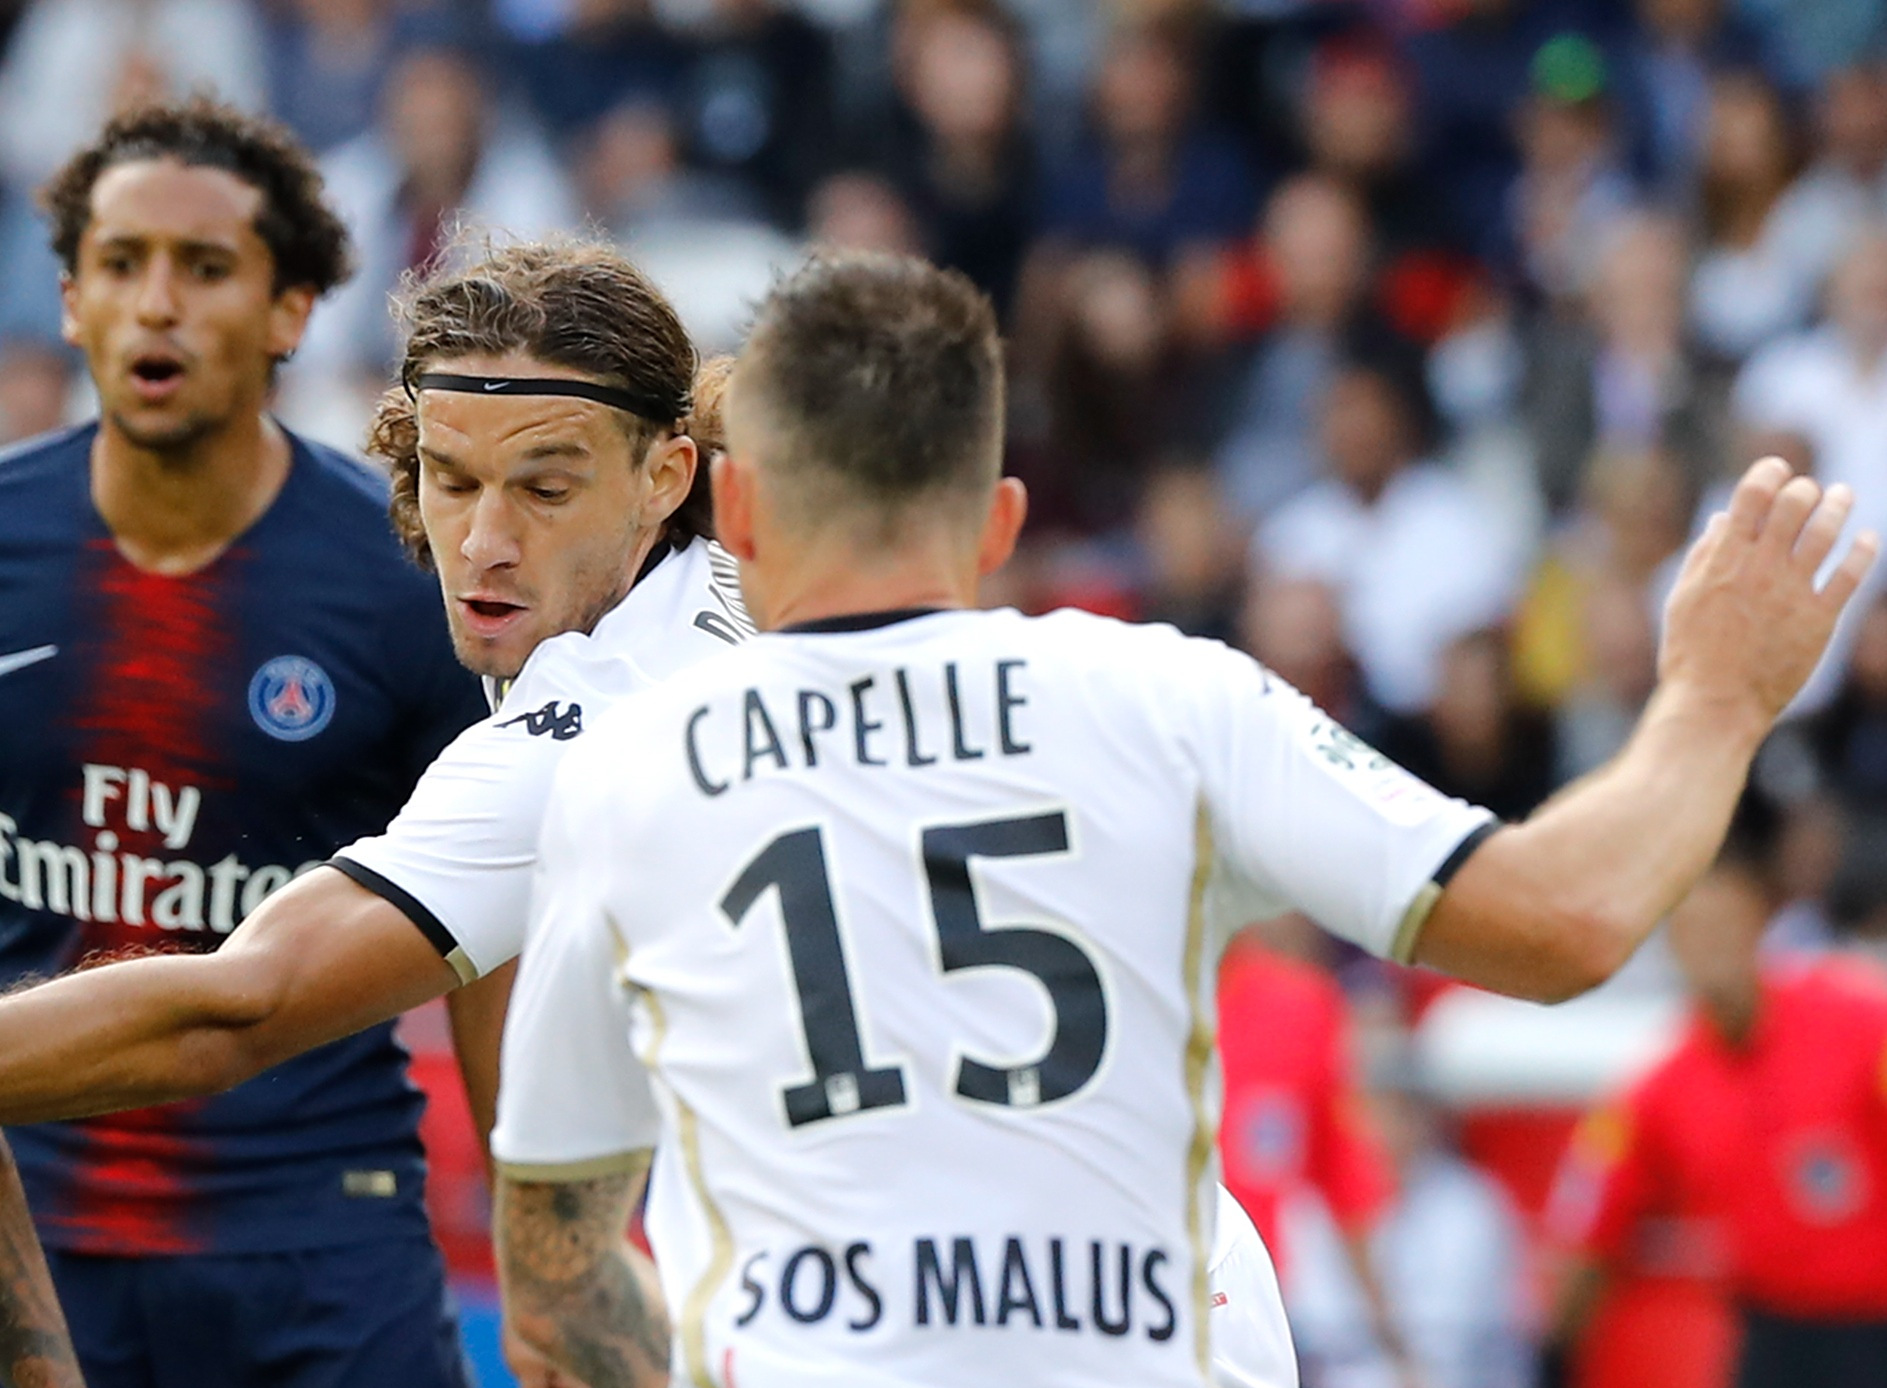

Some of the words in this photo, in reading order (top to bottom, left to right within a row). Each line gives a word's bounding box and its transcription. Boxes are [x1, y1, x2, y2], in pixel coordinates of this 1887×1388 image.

[683, 659, 1033, 798] CAPELLE
[81, 763, 201, 850] Fly
[718, 810, 1111, 1128] 15
[734, 1241, 884, 1333] SOS
[915, 1236, 1178, 1343] MALUS
